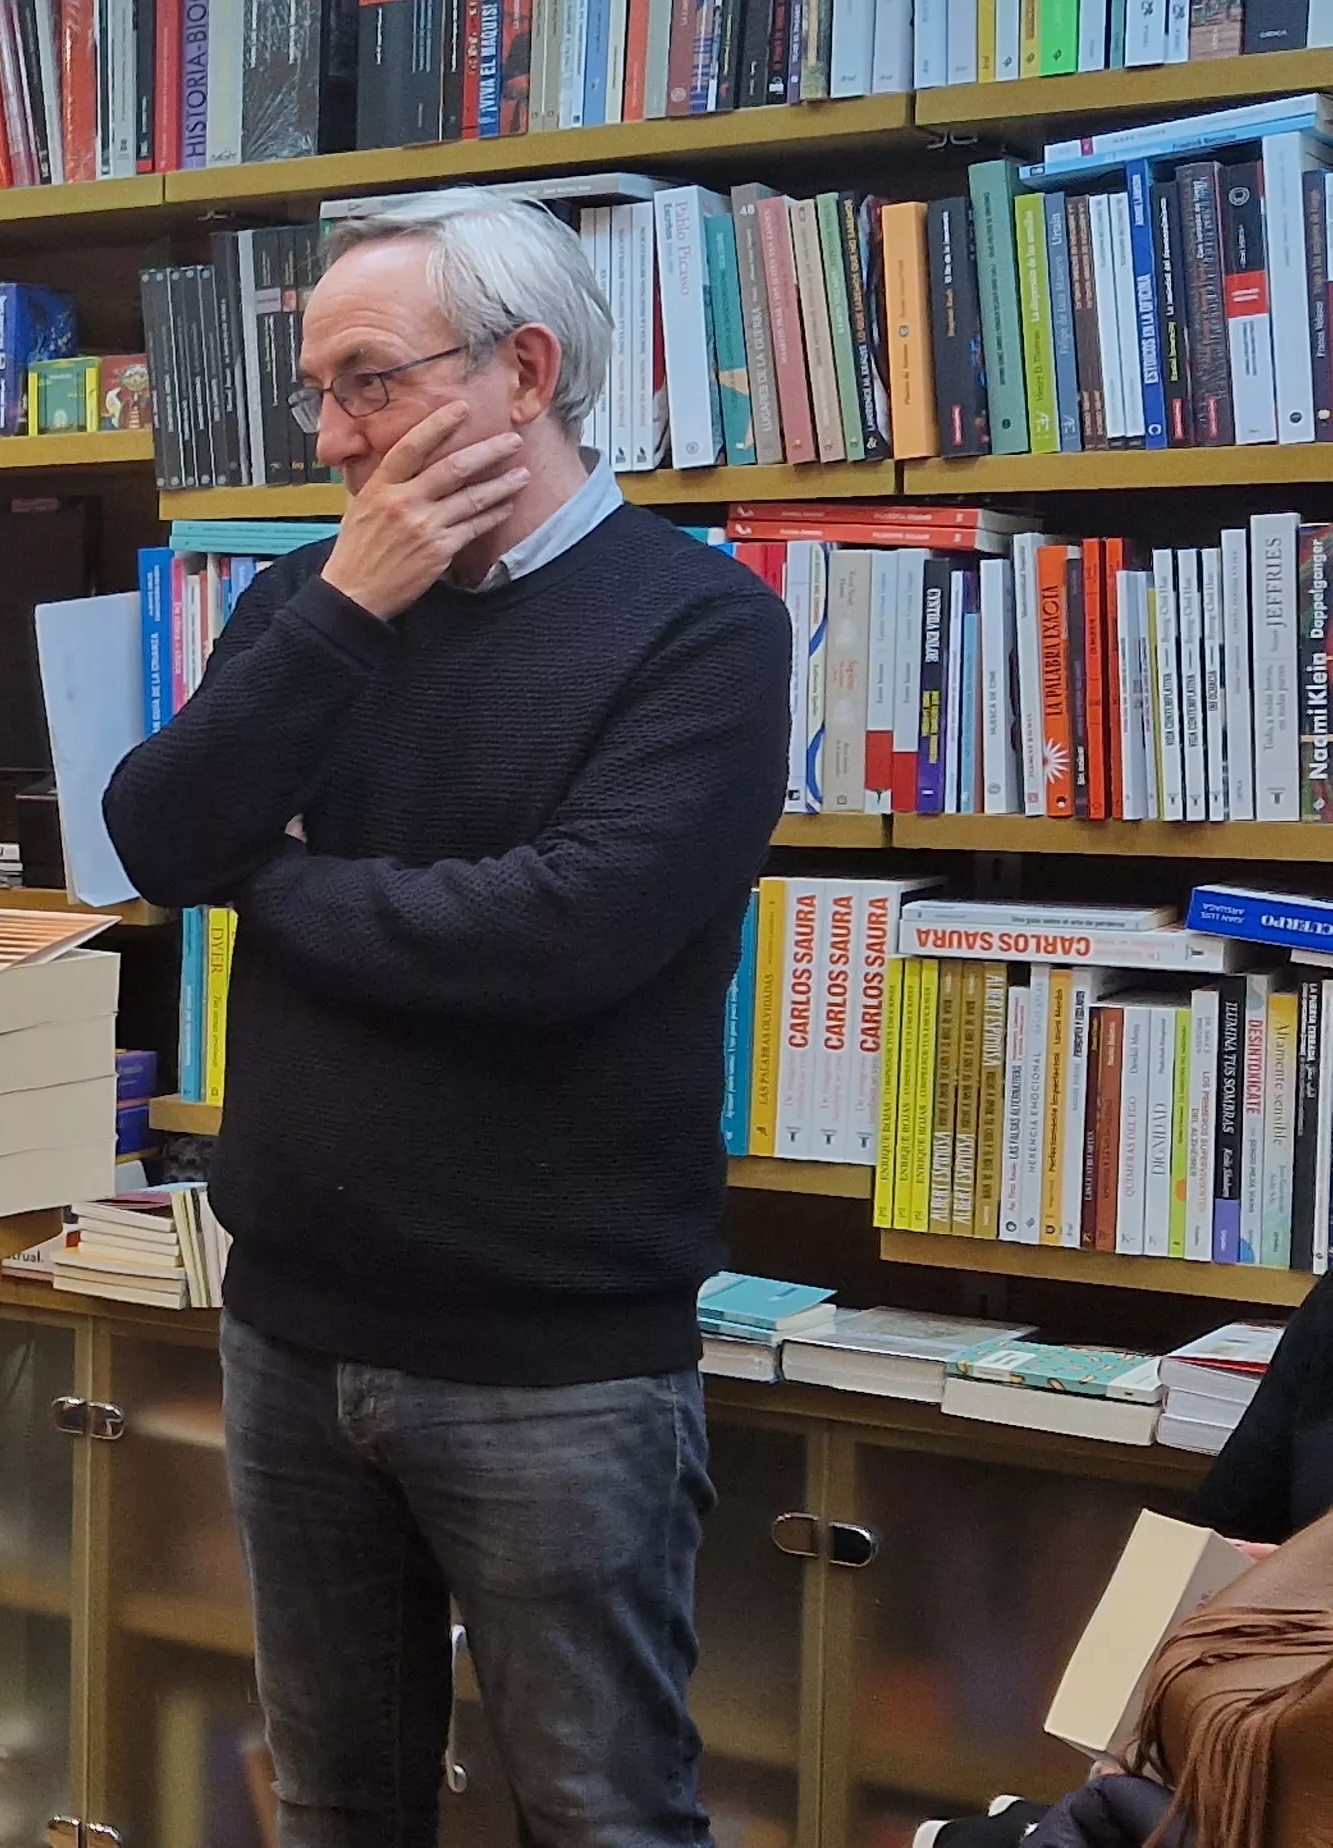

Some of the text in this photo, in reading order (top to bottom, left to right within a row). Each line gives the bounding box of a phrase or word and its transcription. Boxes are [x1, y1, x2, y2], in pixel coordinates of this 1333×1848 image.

[479, 59, 496, 112] ¡VIVA EL
[673, 200, 692, 296] Pablo Picasso
[1058, 314, 1067, 325] de
[1137, 274, 1152, 311] OFICINA
[752, 307, 774, 433] LUGARES DE LA GUERRA
[1035, 376, 1045, 401] Henry
[1159, 575, 1169, 594] Han
[1183, 576, 1192, 595] Han
[1265, 537, 1287, 628] JEFFRIES
[151, 632, 159, 671] CRIANZA
[151, 671, 160, 684] LA
[1044, 642, 1062, 699] PALABRA
[1305, 538, 1329, 781] Naomi Klein Doppelganger
[152, 684, 161, 697] DE
[1045, 701, 1063, 717] LA
[1162, 673, 1175, 729] CONTEMPLATIVA
[1186, 674, 1198, 730] CONTEMPLATIVA
[1165, 729, 1176, 746] VIDA
[211, 927, 225, 973] DYER
[788, 894, 817, 1048] CARLOS SAURA
[824, 896, 853, 1051] CARLOS SAURA
[860, 897, 889, 1053] CARLOS SAURA
[915, 928, 1091, 957] CARLOS SAURA
[760, 973, 774, 1105] LAS PALABRAS OLVIDADAS
[983, 974, 1004, 1067] ALBERT ESPINOSA
[1221, 1002, 1238, 1134] ILUMINA TUS SOMBRAS
[1272, 1019, 1290, 1145] Altamente sensible
[880, 1102, 893, 1181] ENRIQUE ROJAS
[900, 1102, 911, 1181] ENRIQUE ROJAS
[916, 1104, 927, 1184] ENRIQUE ROJAS
[1010, 1065, 1022, 1159] LAS FALSAS ALTERNATIVAS
[1028, 1051, 1041, 1173] HERENCIA EMOCIONAL
[1126, 1095, 1137, 1197] QUIMERAS DEL EGO
[1150, 1103, 1168, 1176] DIGNIDAD
[932, 1131, 952, 1181] ESPINOSA
[953, 1134, 974, 1224] ALBERT ESPINOSA
[931, 1183, 950, 1221] ALBERT
